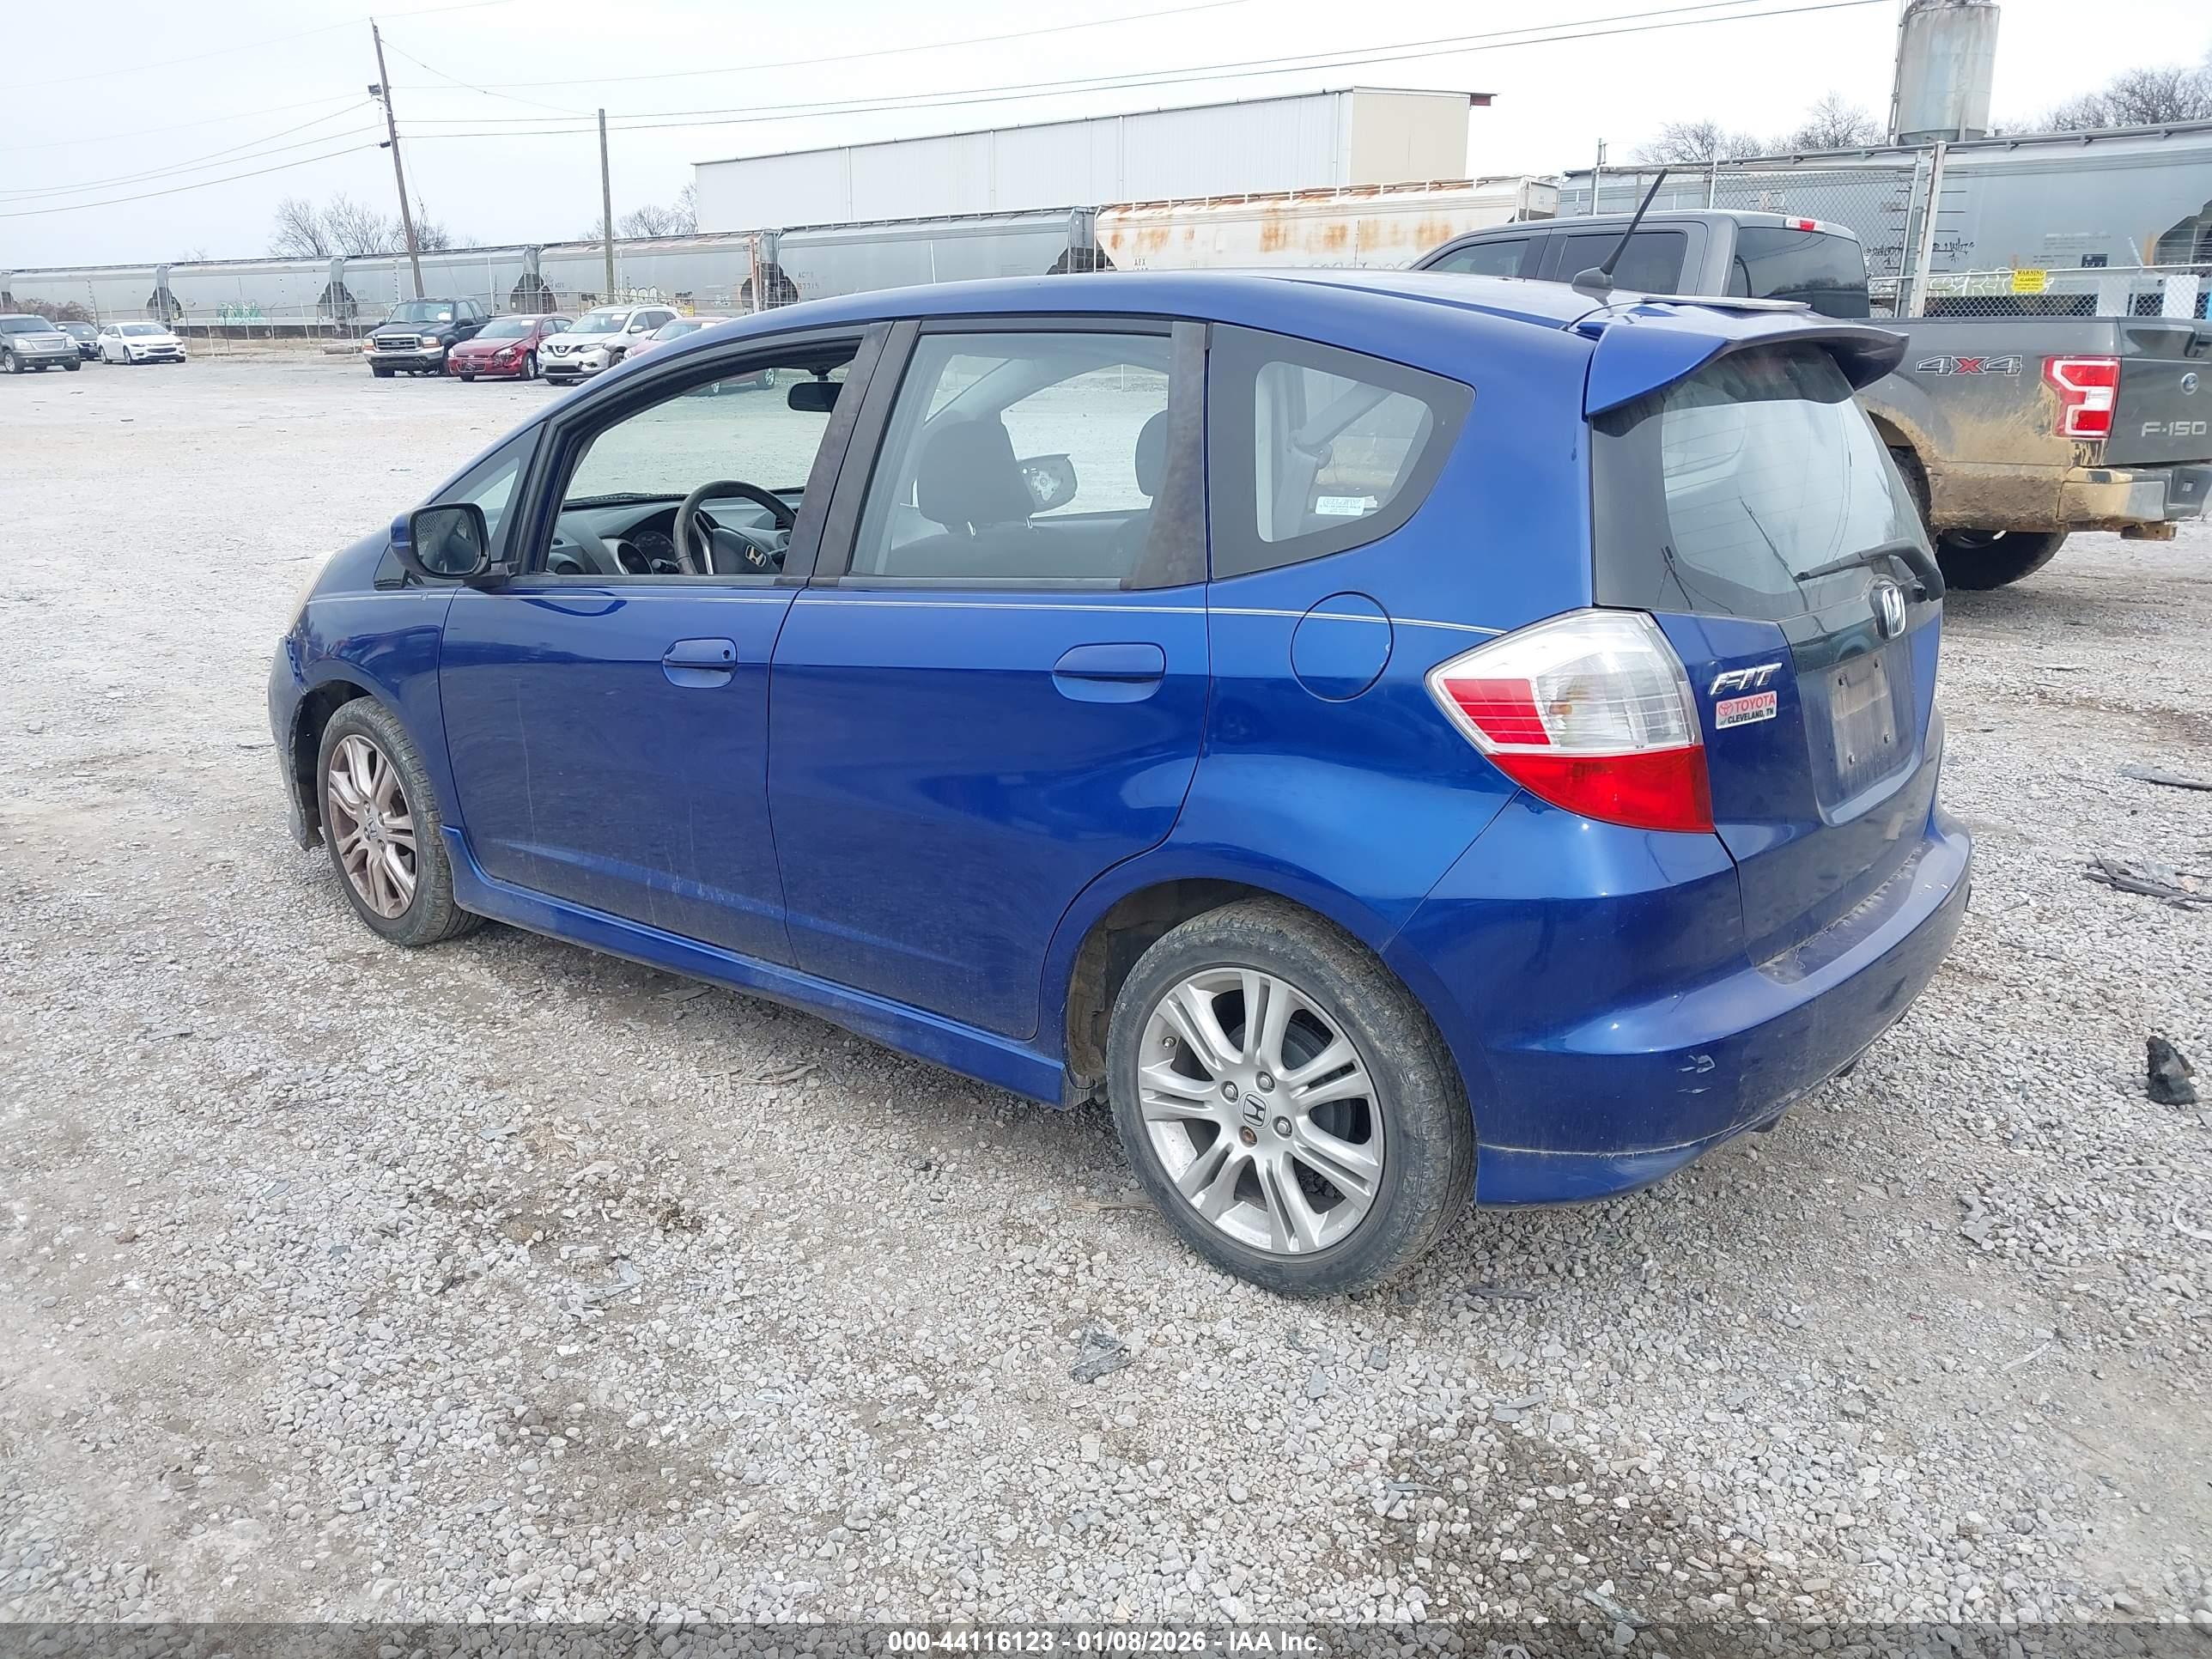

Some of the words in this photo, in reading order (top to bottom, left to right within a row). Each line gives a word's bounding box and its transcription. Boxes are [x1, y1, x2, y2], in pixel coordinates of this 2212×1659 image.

[2142, 421, 2207, 438] F-150
[1708, 662, 1783, 696] FIT
[1735, 694, 1776, 714] TOYOTA
[1728, 708, 1765, 725] CLEVELAND,
[1766, 707, 1774, 716] TN
